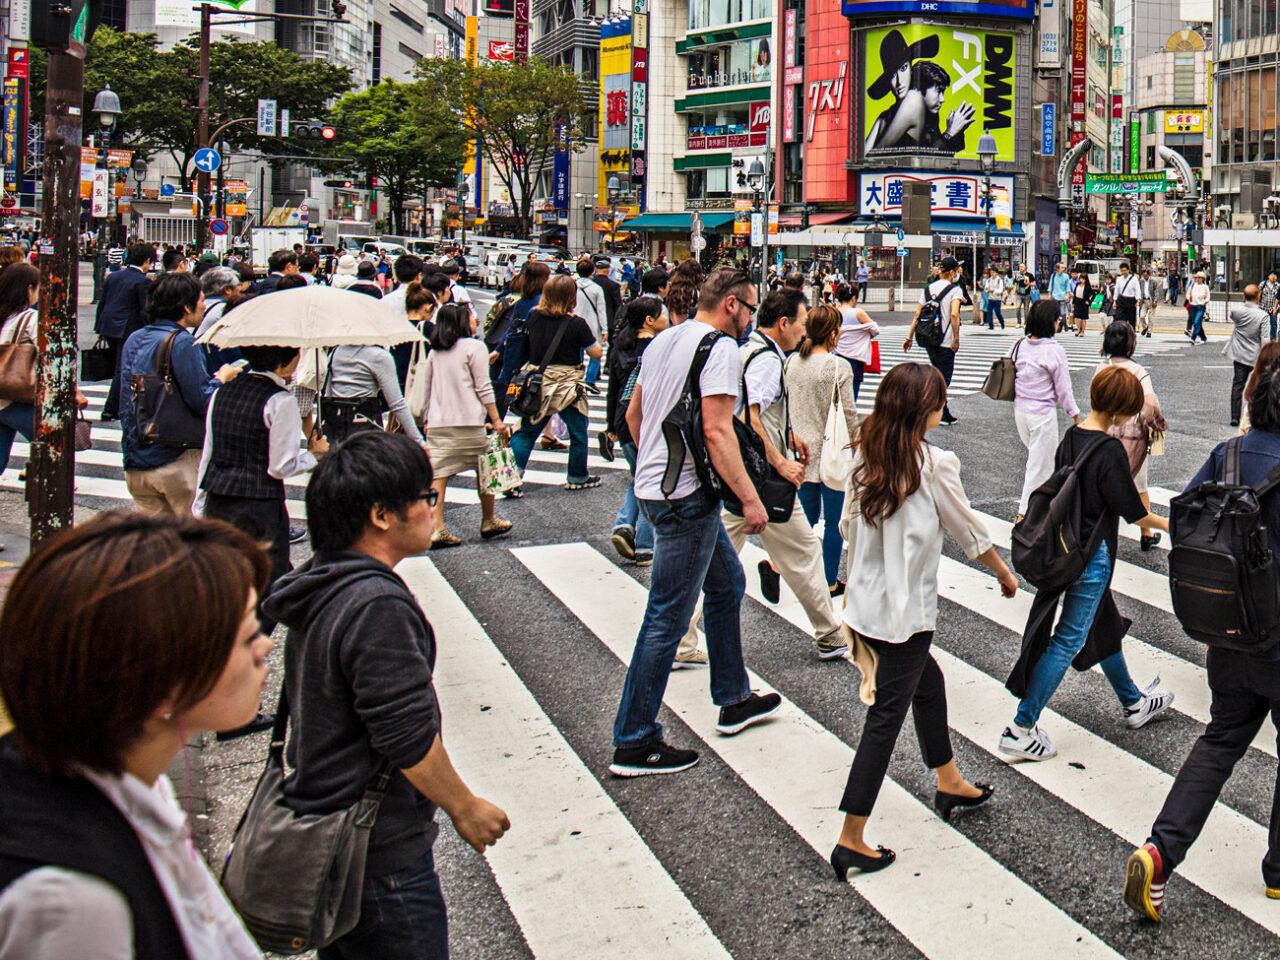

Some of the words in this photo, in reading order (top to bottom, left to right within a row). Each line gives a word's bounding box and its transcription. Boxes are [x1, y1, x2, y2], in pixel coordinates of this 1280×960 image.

[921, 2, 939, 11] DHC
[951, 30, 983, 97] FX
[983, 33, 1014, 131] DMM
[606, 90, 628, 127] 薬
[806, 61, 848, 142] クスリ
[1072, 66, 1086, 115] 三千里
[752, 105, 771, 128] JTB
